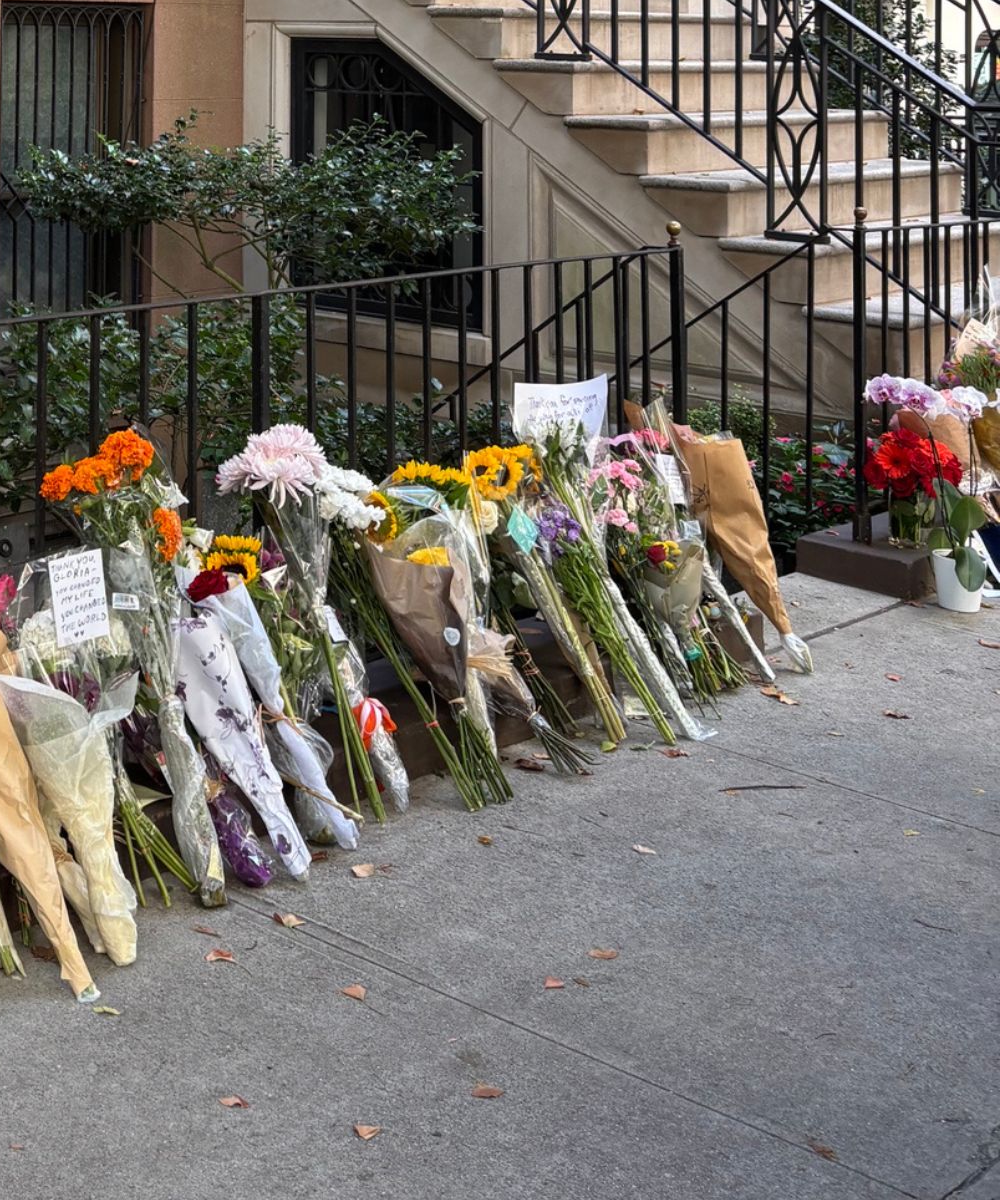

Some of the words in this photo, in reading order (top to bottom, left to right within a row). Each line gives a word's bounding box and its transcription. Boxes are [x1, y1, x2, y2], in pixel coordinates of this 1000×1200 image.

[60, 595, 74, 605] MY
[75, 588, 95, 600] LIFE
[62, 622, 76, 633] THE
[77, 612, 107, 628] WORLD
